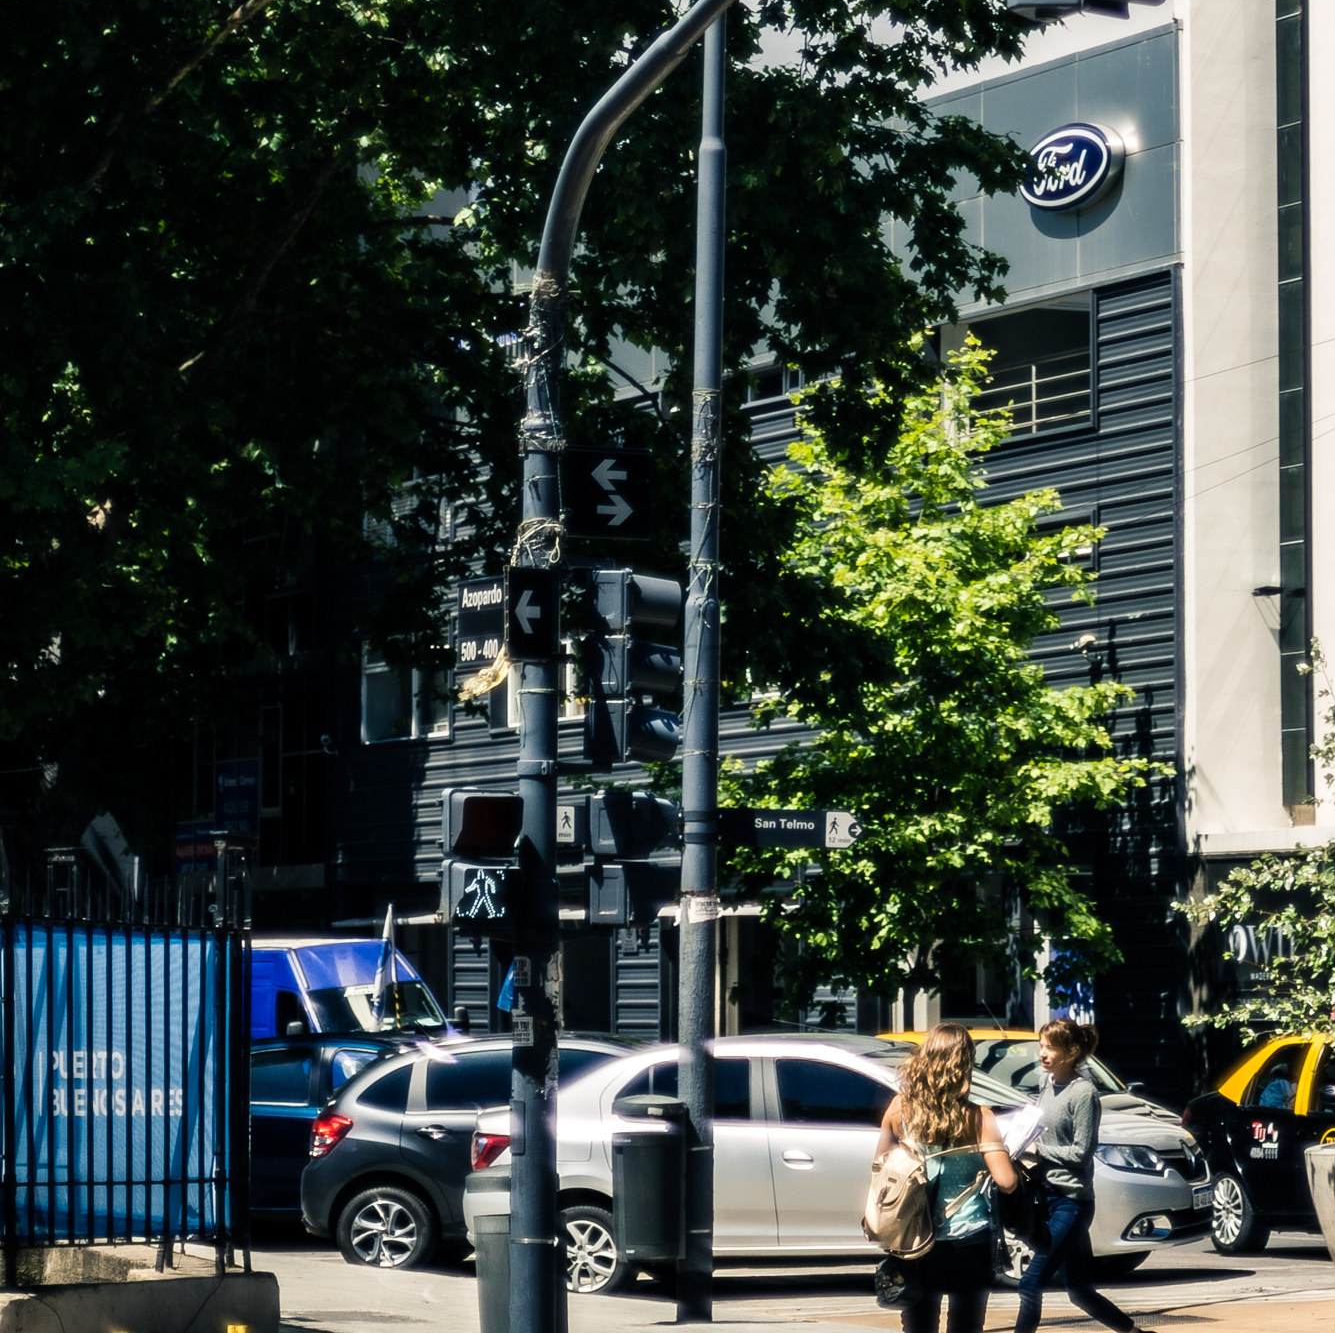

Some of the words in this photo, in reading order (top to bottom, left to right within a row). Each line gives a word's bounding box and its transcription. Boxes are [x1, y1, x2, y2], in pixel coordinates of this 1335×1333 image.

[461, 583, 503, 611] Azopardo
[754, 817, 776, 829] San
[779, 818, 815, 830] Telmo
[838, 836, 851, 844] min
